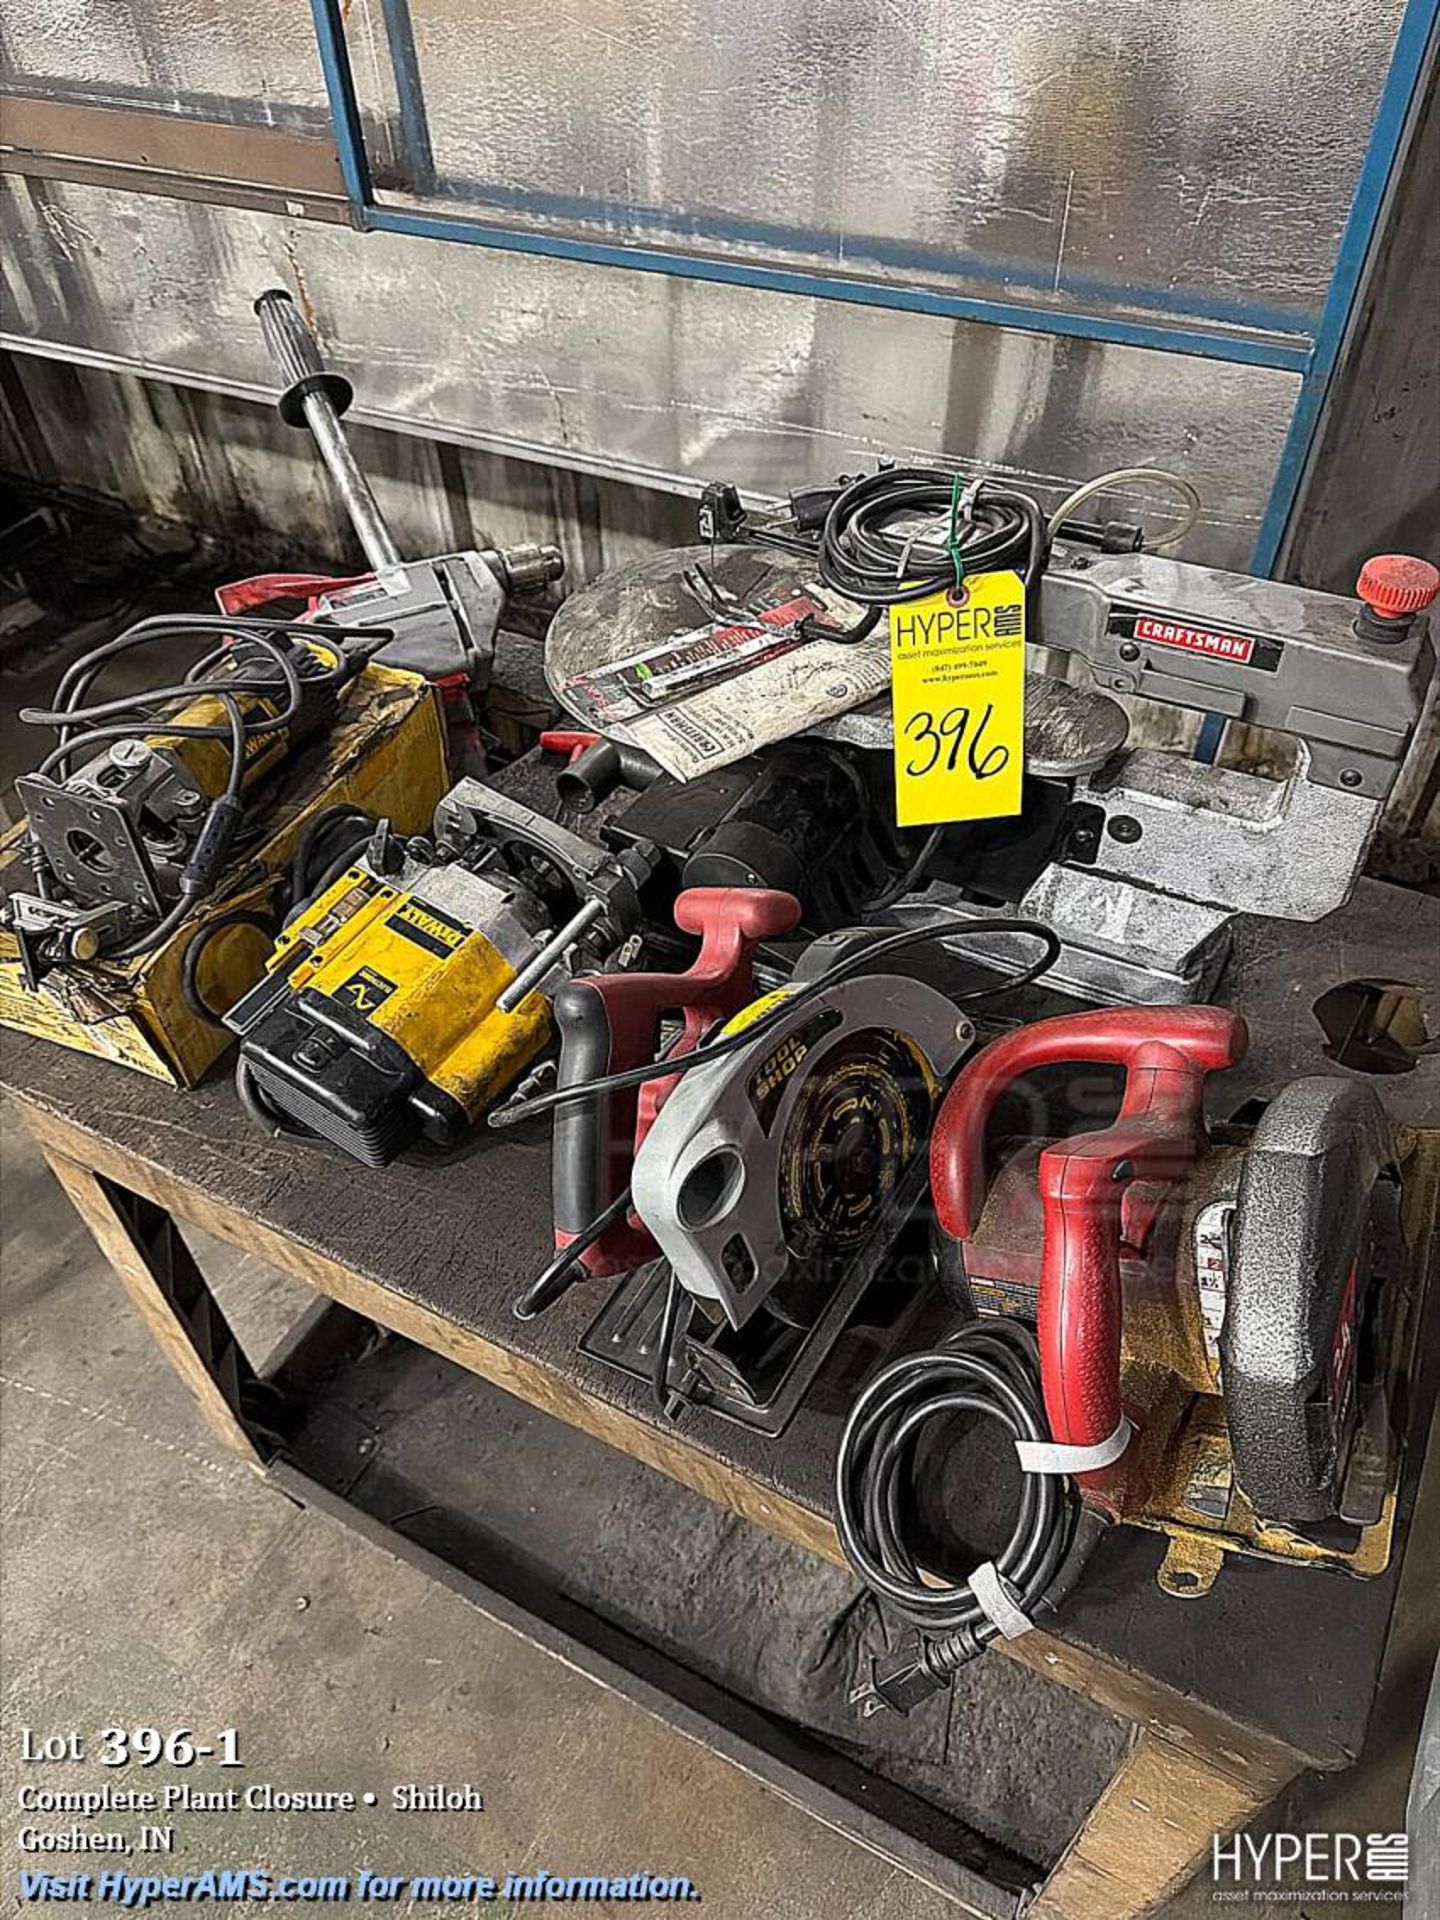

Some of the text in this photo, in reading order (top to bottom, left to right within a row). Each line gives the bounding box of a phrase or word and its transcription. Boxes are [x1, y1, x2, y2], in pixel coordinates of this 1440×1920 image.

[897, 607, 991, 647] HYPER
[1142, 619, 1246, 659] CRAFTSMAN
[898, 649, 921, 660] asset
[985, 640, 1022, 651] services
[664, 710, 716, 752] CRAFTSMAN
[904, 704, 1009, 780] 396
[755, 1036, 801, 1085] TOOL
[756, 1044, 808, 1101] SHOP
